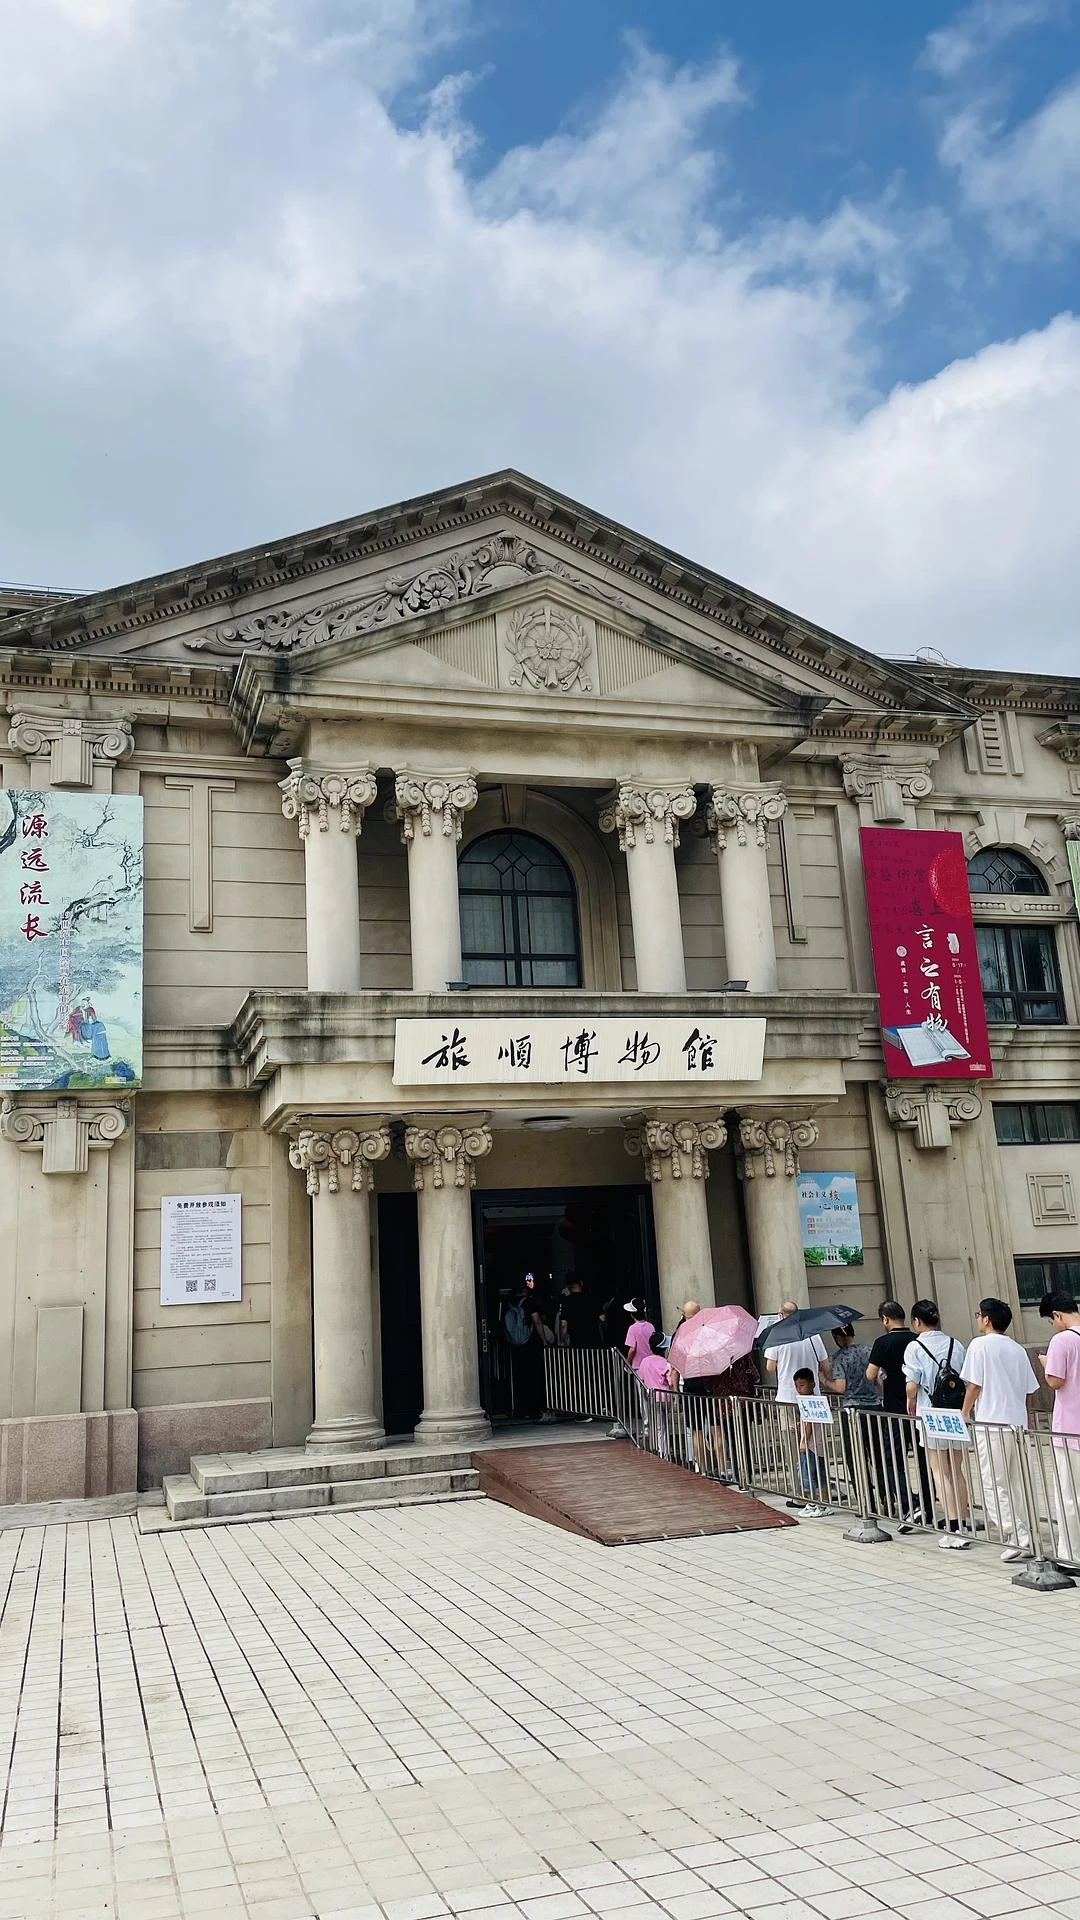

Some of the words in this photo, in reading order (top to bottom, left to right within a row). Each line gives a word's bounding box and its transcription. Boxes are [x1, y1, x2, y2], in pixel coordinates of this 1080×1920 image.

[19, 814, 50, 941] 源远流长
[915, 923, 948, 1032] 言之有物
[421, 1027, 718, 1074] 旅順博物館
[925, 1413, 965, 1434] 禁止翻越
